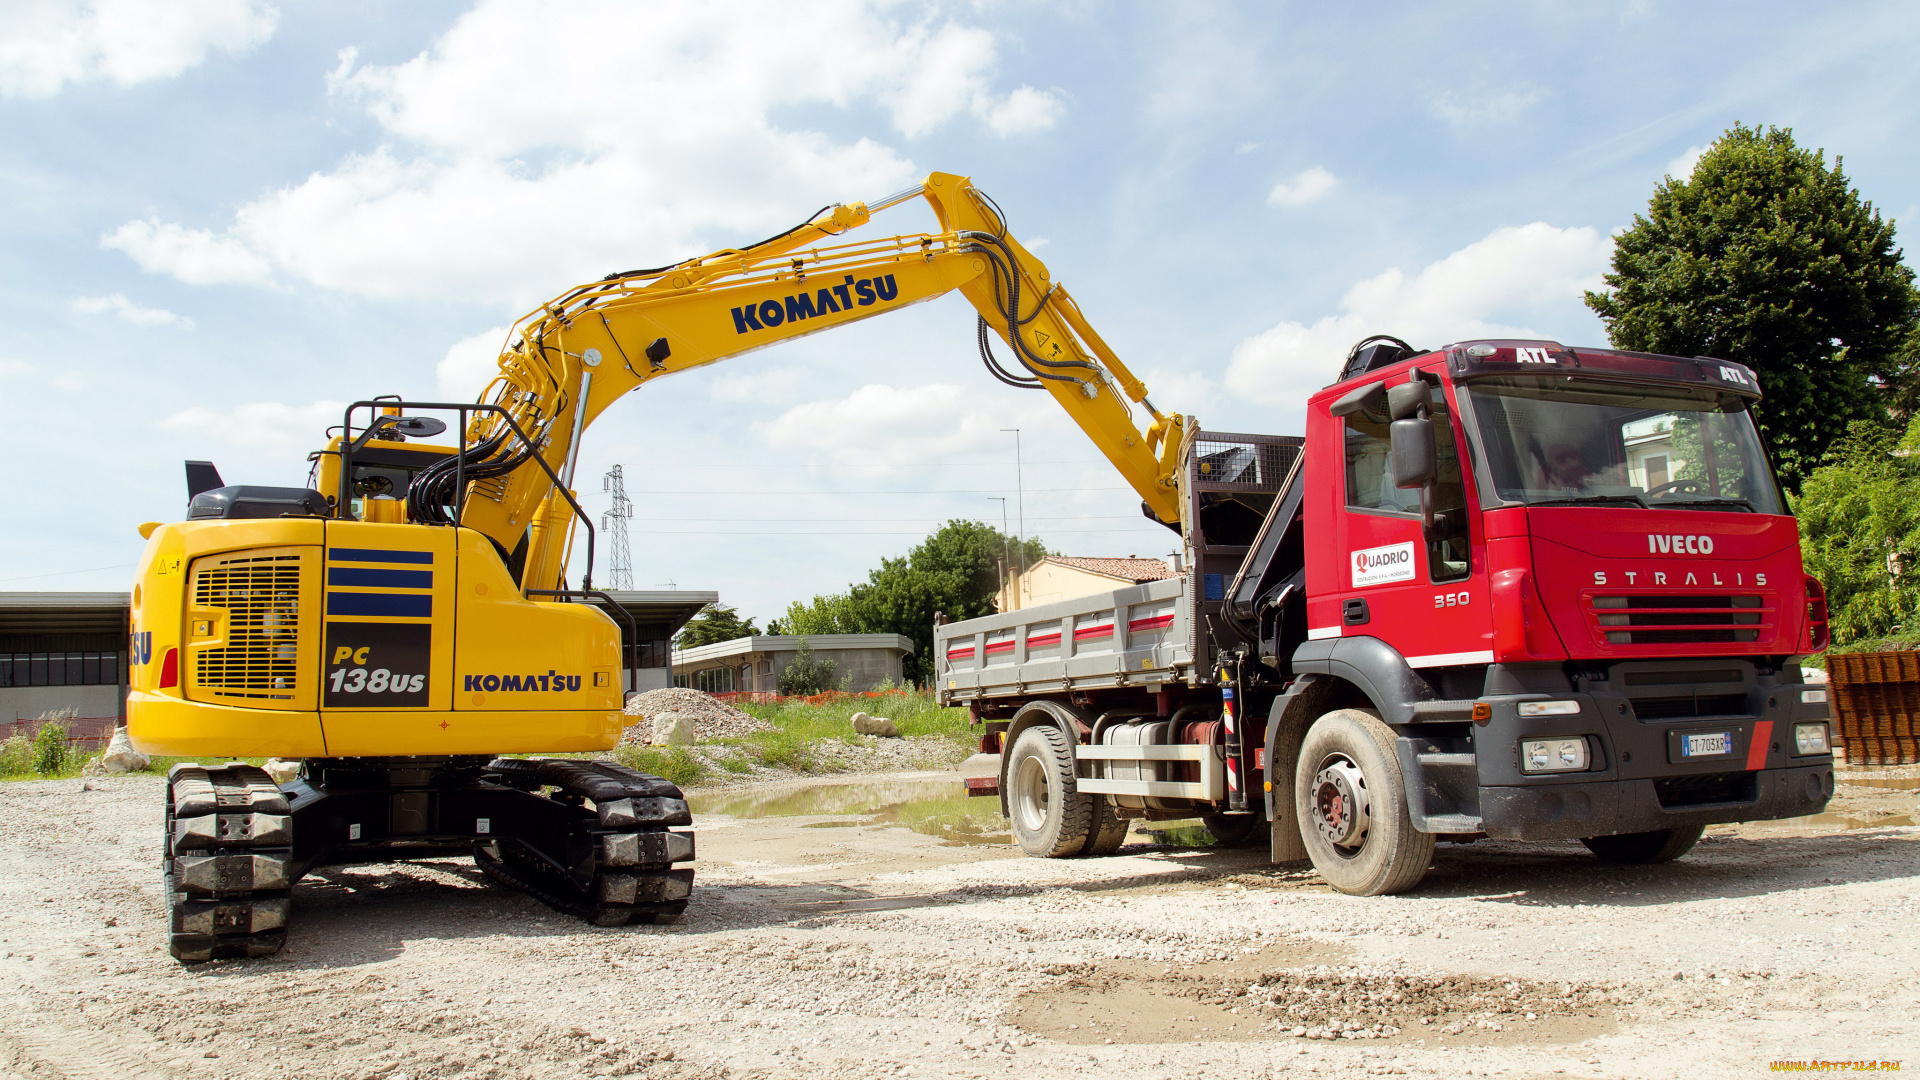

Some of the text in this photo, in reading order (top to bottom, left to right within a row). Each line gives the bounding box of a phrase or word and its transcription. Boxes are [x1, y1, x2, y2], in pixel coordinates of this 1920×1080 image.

[731, 274, 898, 334] KOMATSU
[1516, 347, 1557, 364] ATL
[1719, 365, 1749, 385] ATL
[1648, 534, 1714, 555] IVECO
[1356, 550, 1409, 573] QUADRIO
[1594, 571, 1767, 586] STRALIS
[1434, 591, 1470, 609] 350
[332, 646, 370, 665] PC
[464, 670, 581, 692] KOMATSU
